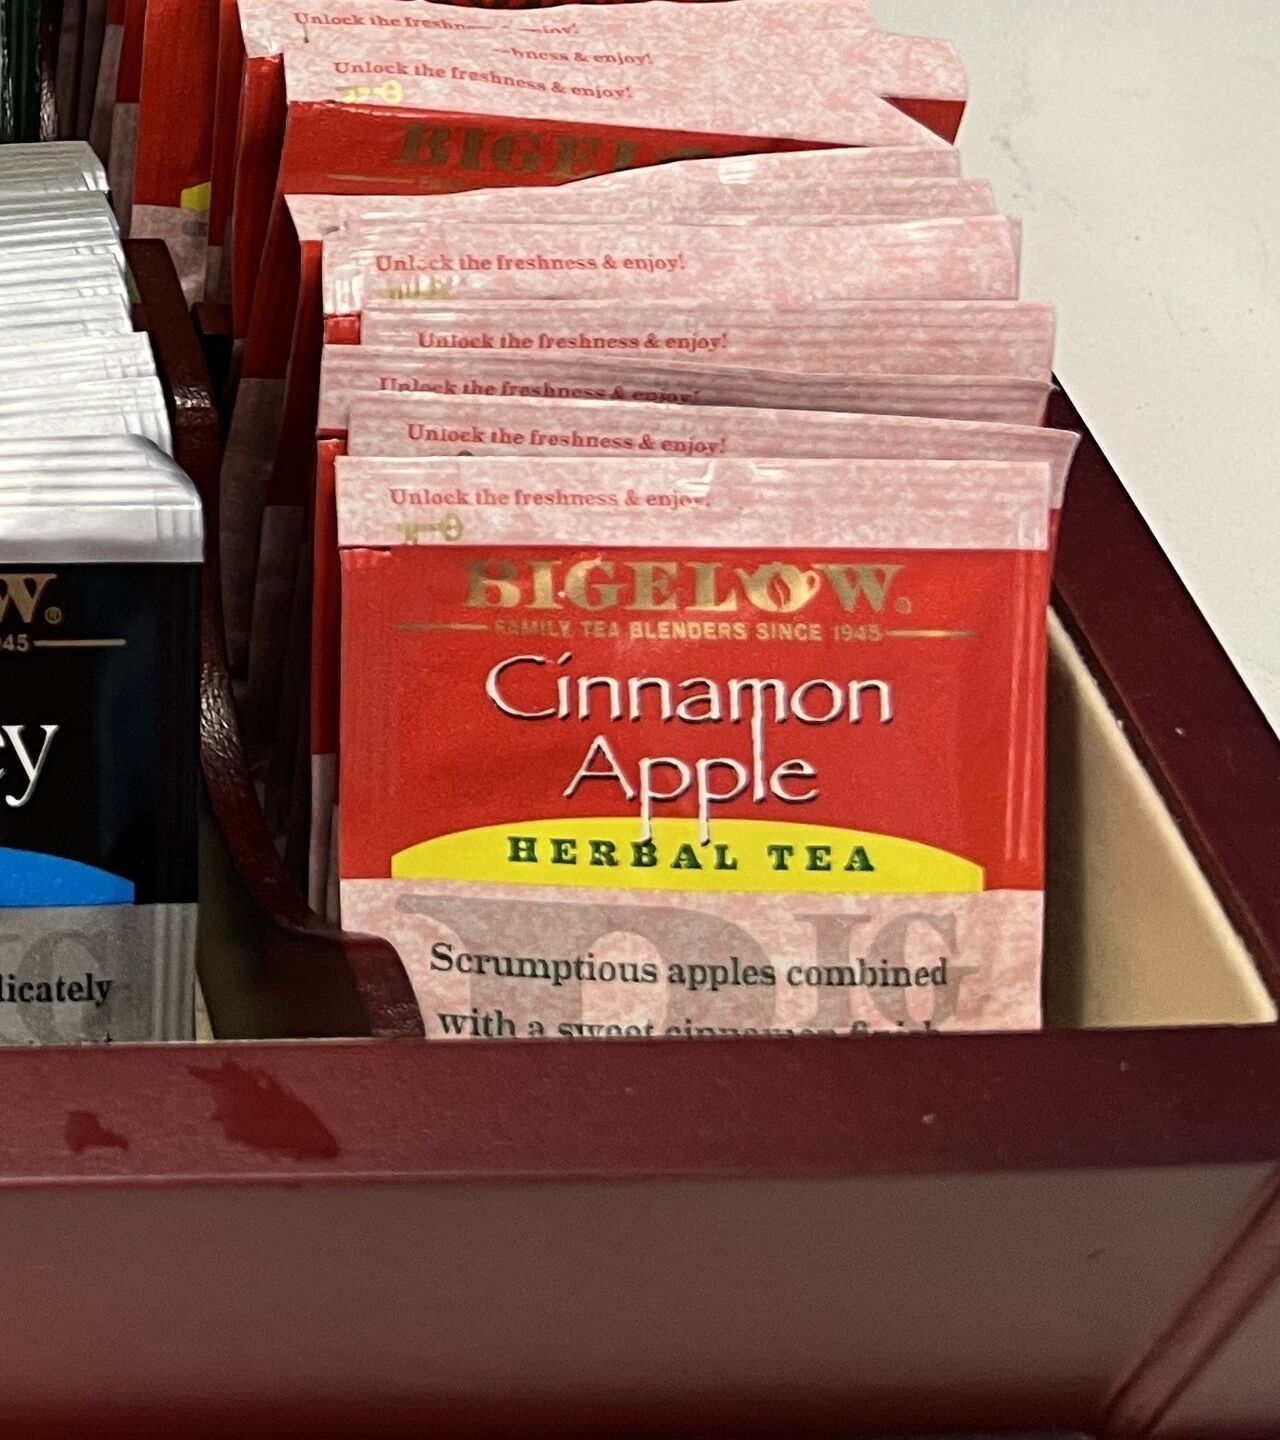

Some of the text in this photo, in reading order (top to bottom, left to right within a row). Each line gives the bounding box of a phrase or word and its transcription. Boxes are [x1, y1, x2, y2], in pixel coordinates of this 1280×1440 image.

[334, 62, 631, 99] Unlock the freshness & enjoy!
[458, 255, 685, 273] the freshness & enjoy!
[418, 332, 727, 352] Unlock the freshness & enjoy!
[407, 423, 726, 456] Unlock the freshness & enjoy!
[389, 488, 639, 505] Unlock the freshness &
[494, 619, 882, 641] FAMILY TEA BLENDERS SINCE 1945
[486, 652, 892, 725] Cinnamon
[563, 735, 818, 846] Apple
[507, 836, 874, 871] HERBAL TEA
[430, 943, 948, 991] Scrumptious apples combined
[437, 1010, 516, 1037] with
